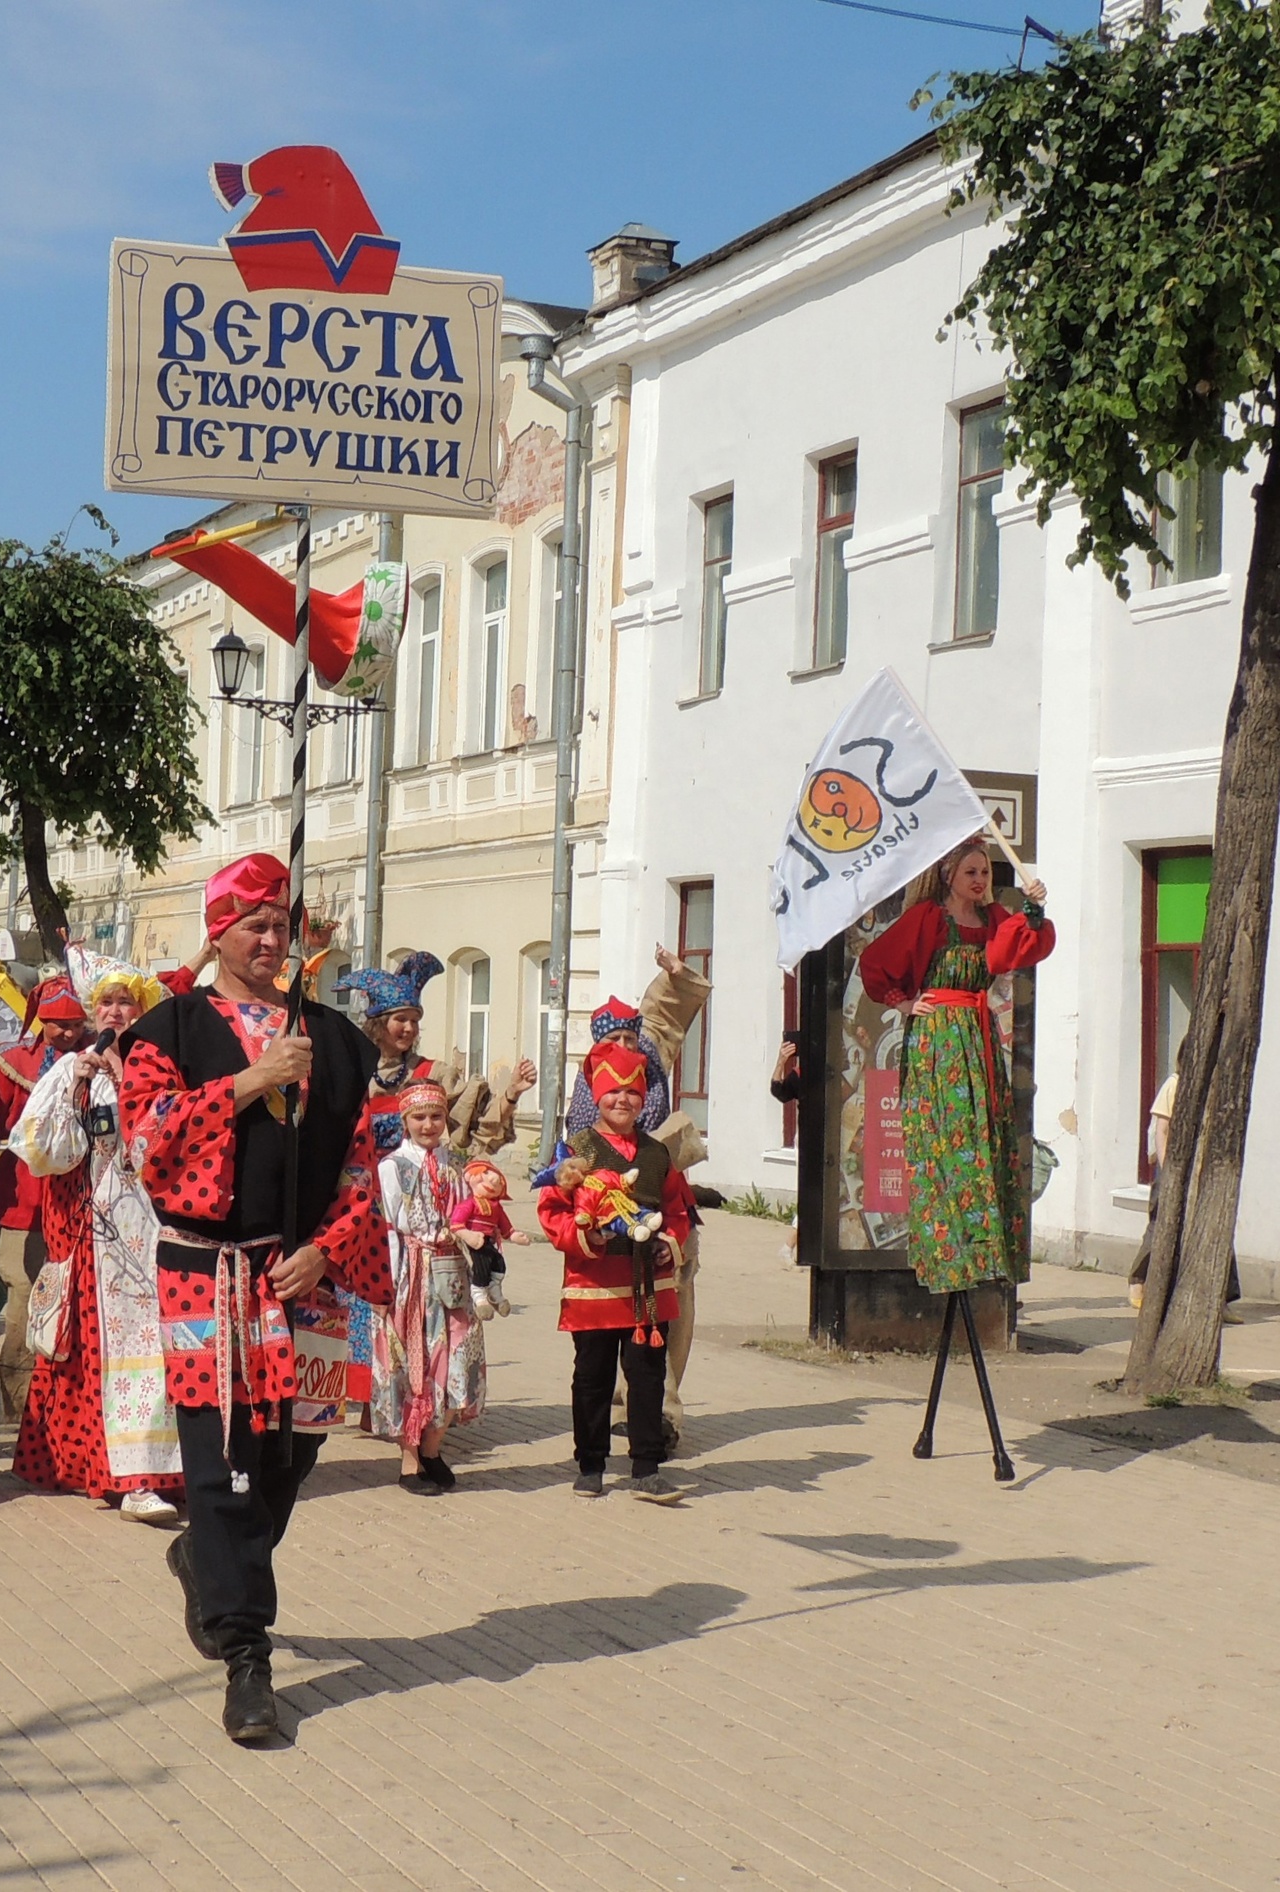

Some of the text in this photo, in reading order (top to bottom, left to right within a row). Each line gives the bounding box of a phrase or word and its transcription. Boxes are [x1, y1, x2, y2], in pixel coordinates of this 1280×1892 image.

[157, 282, 464, 384] ВЕРСТА
[157, 361, 463, 425] СТАРОРУССКОГО
[155, 415, 461, 479] ПЕТРУШКИ
[880, 1096, 900, 1111] СУ
[881, 1120, 903, 1128] ВОСК
[893, 1148, 905, 1158] 91
